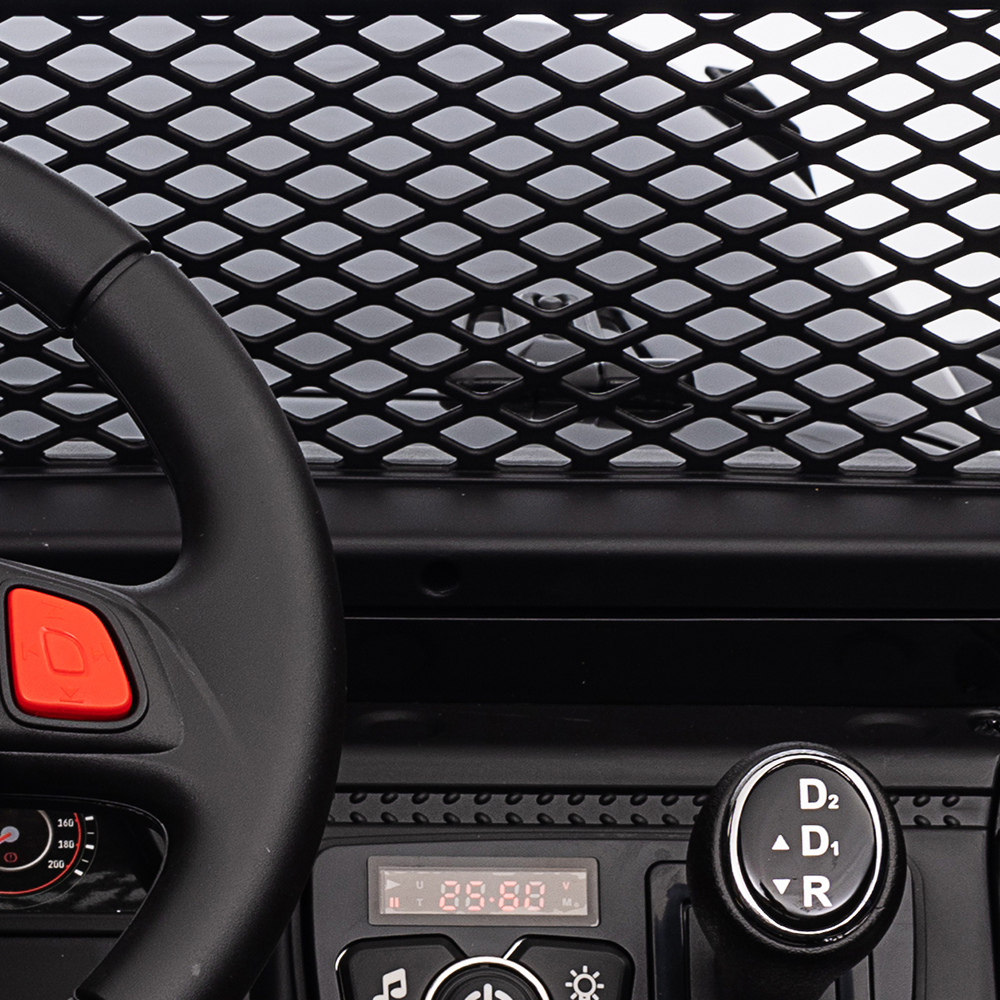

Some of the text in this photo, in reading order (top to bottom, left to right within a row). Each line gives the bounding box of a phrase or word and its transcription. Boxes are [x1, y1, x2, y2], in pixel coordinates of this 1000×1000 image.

[57, 818, 74, 828] 160
[57, 840, 75, 849] 180
[48, 860, 65, 869] 200
[562, 881, 570, 890] V
[802, 875, 833, 908] R
